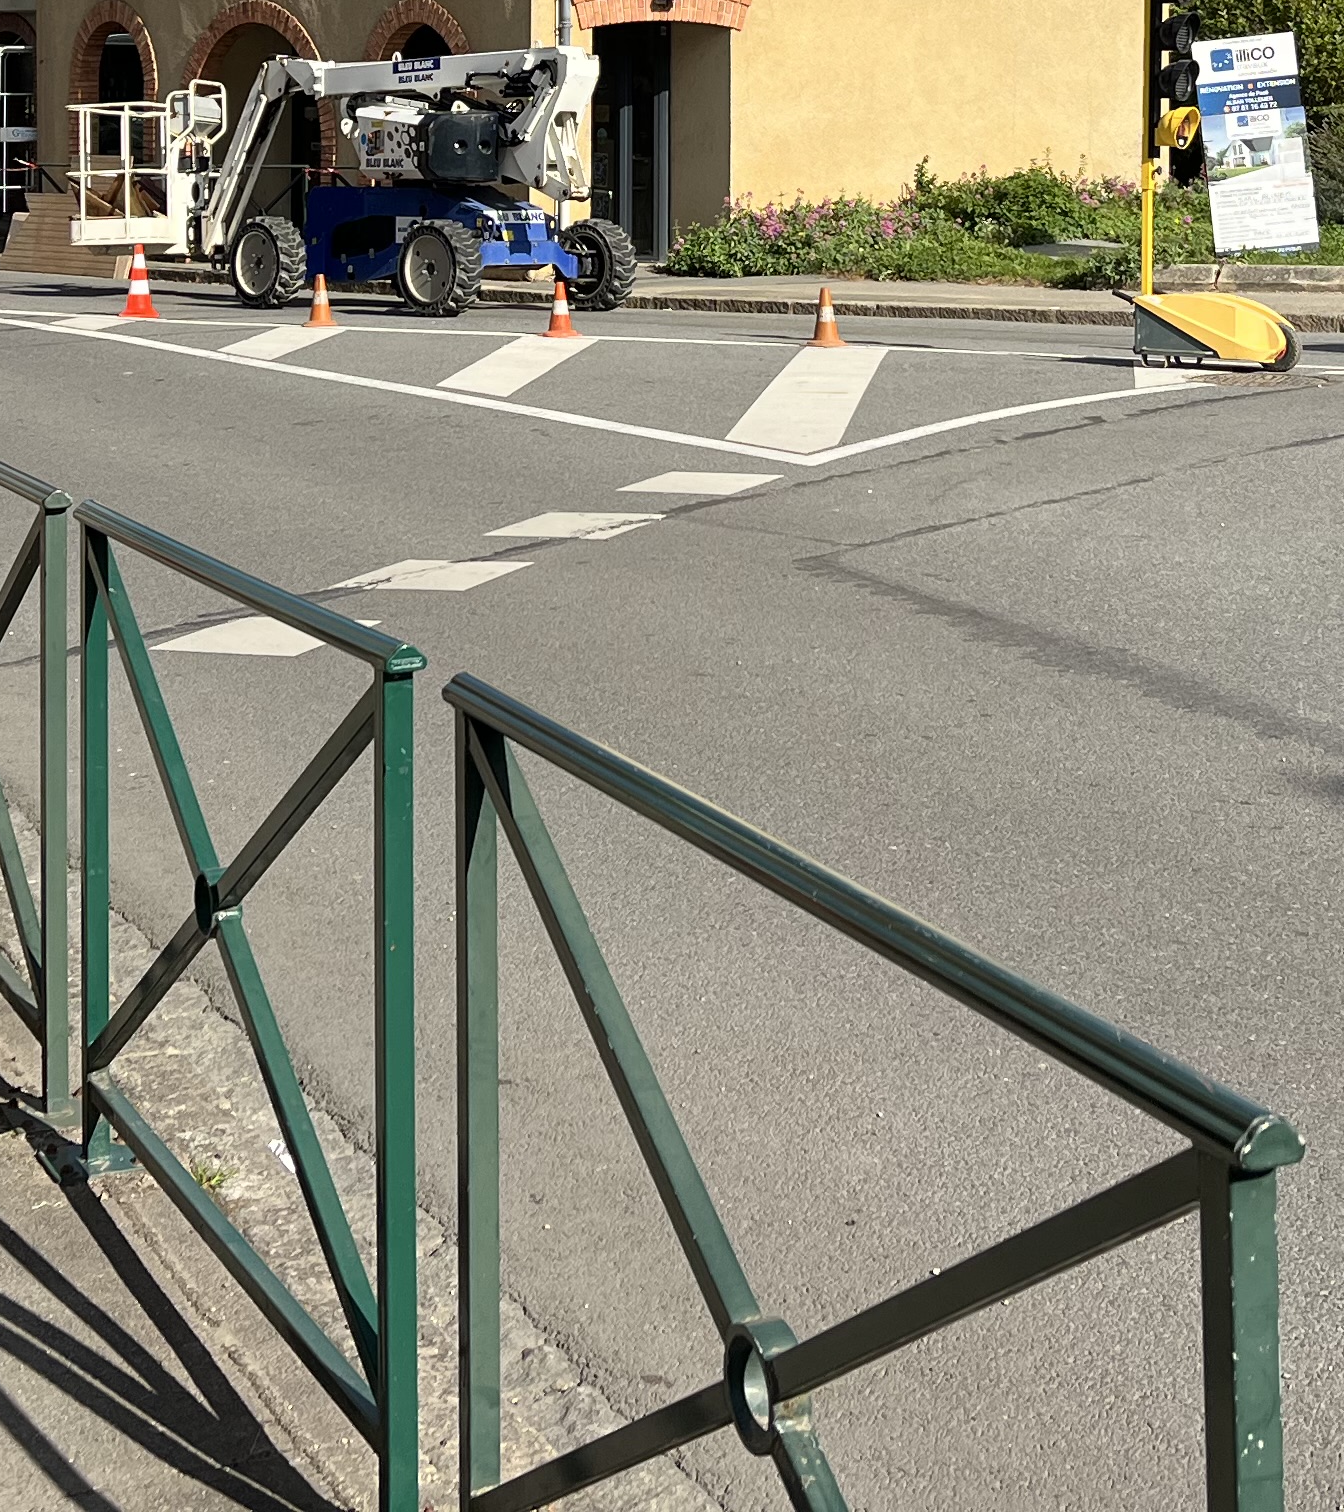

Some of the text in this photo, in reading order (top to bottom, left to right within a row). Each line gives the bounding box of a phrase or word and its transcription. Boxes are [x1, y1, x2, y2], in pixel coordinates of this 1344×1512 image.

[414, 60, 434, 69] BLANC
[414, 72, 434, 81] BLANC
[382, 158, 404, 168] BLANC
